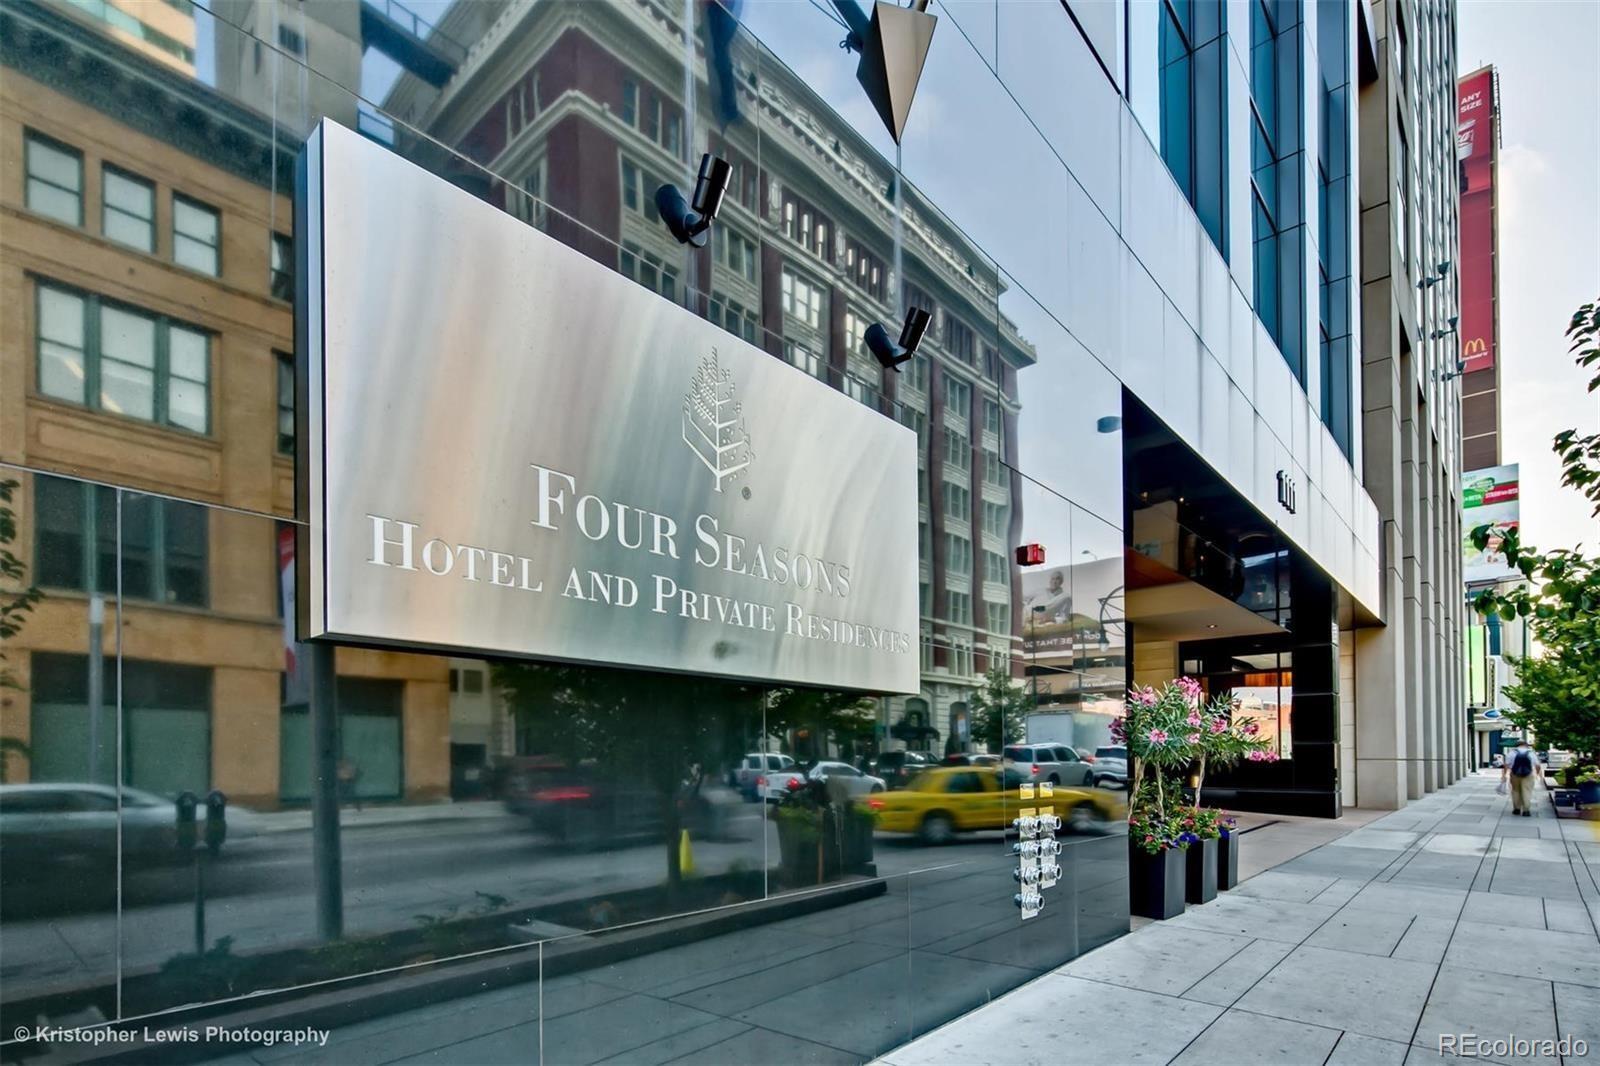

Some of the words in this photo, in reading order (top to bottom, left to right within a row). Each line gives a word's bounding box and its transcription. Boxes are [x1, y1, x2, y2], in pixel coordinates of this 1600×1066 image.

[1460, 91, 1482, 105] ANY
[1460, 98, 1483, 113] SIZE
[529, 463, 679, 560] FOUR
[694, 513, 851, 598] SEASONS
[365, 513, 543, 593] HOTEL
[561, 566, 639, 608] AND
[651, 574, 776, 632] PRIVATE
[784, 602, 911, 654] RESIDENCES
